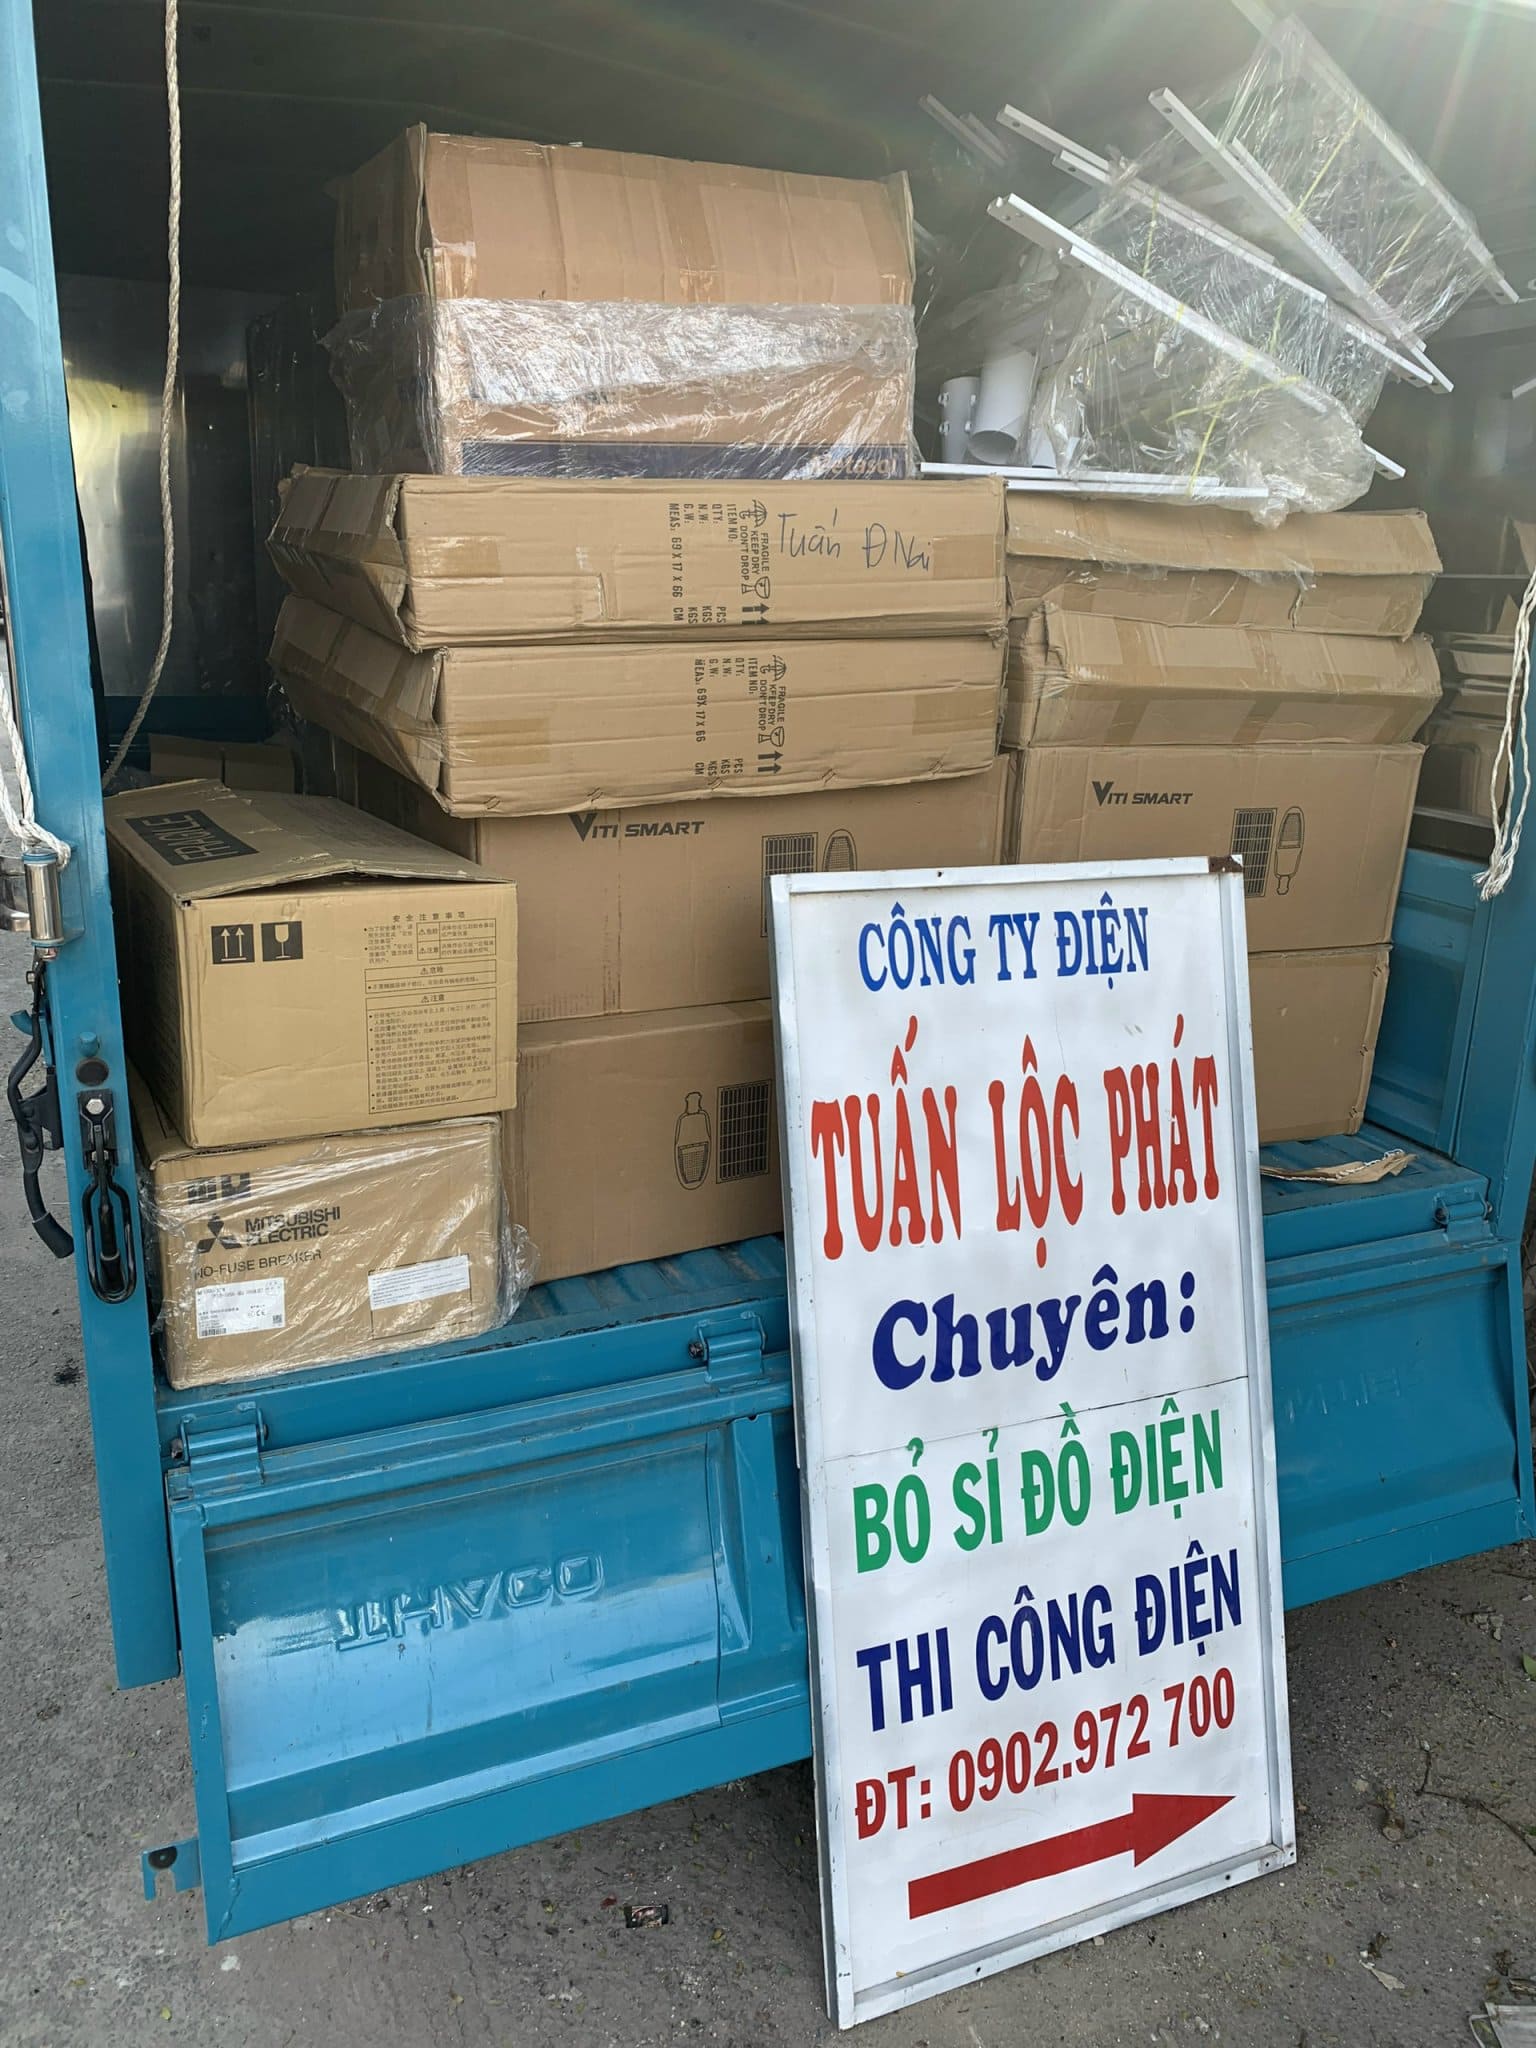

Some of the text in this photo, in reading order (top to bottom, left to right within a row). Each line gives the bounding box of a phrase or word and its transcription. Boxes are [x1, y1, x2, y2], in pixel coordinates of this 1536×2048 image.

[811, 455, 897, 475] etasol
[726, 503, 738, 525] ITEM
[671, 537, 682, 551] 69
[739, 525, 750, 581] DON'T DROP
[751, 530, 760, 575] KEEP DRY
[761, 532, 770, 572] FRAGILE
[671, 562, 683, 572] 17
[672, 585, 683, 598] 66
[673, 607, 684, 622] CM
[687, 606, 698, 625] KGS
[702, 605, 713, 624] KGS
[716, 606, 727, 624] PCS
[747, 657, 758, 678] ITEM
[695, 711, 706, 719] 17
[767, 683, 777, 726] KEEP DRY
[776, 686, 786, 723] FRAGILE
[758, 707, 767, 732] DROP
[695, 730, 706, 743] 66
[694, 761, 705, 775] CM
[707, 760, 718, 777] KGS
[720, 758, 731, 775] KGS
[734, 758, 744, 774] PCS
[1131, 792, 1194, 805] SMART
[141, 813, 240, 861] FRAGILE
[624, 820, 705, 838] SMART
[858, 891, 1149, 992] CÔNG TY ĐIỆN
[811, 1014, 1219, 1269] TUẤN LỘC PHÁT
[245, 1206, 341, 1233] MITSUBISHI
[258, 1249, 322, 1270] BREAKER
[872, 1263, 1196, 1391] Chuyên:
[853, 1397, 1223, 1573] BỎ SỈ ĐỒ ĐIỆN
[856, 1539, 1242, 1732] THI CÔNG ĐIỆN
[854, 1667, 1235, 1840] ĐT: 0902.972 700
